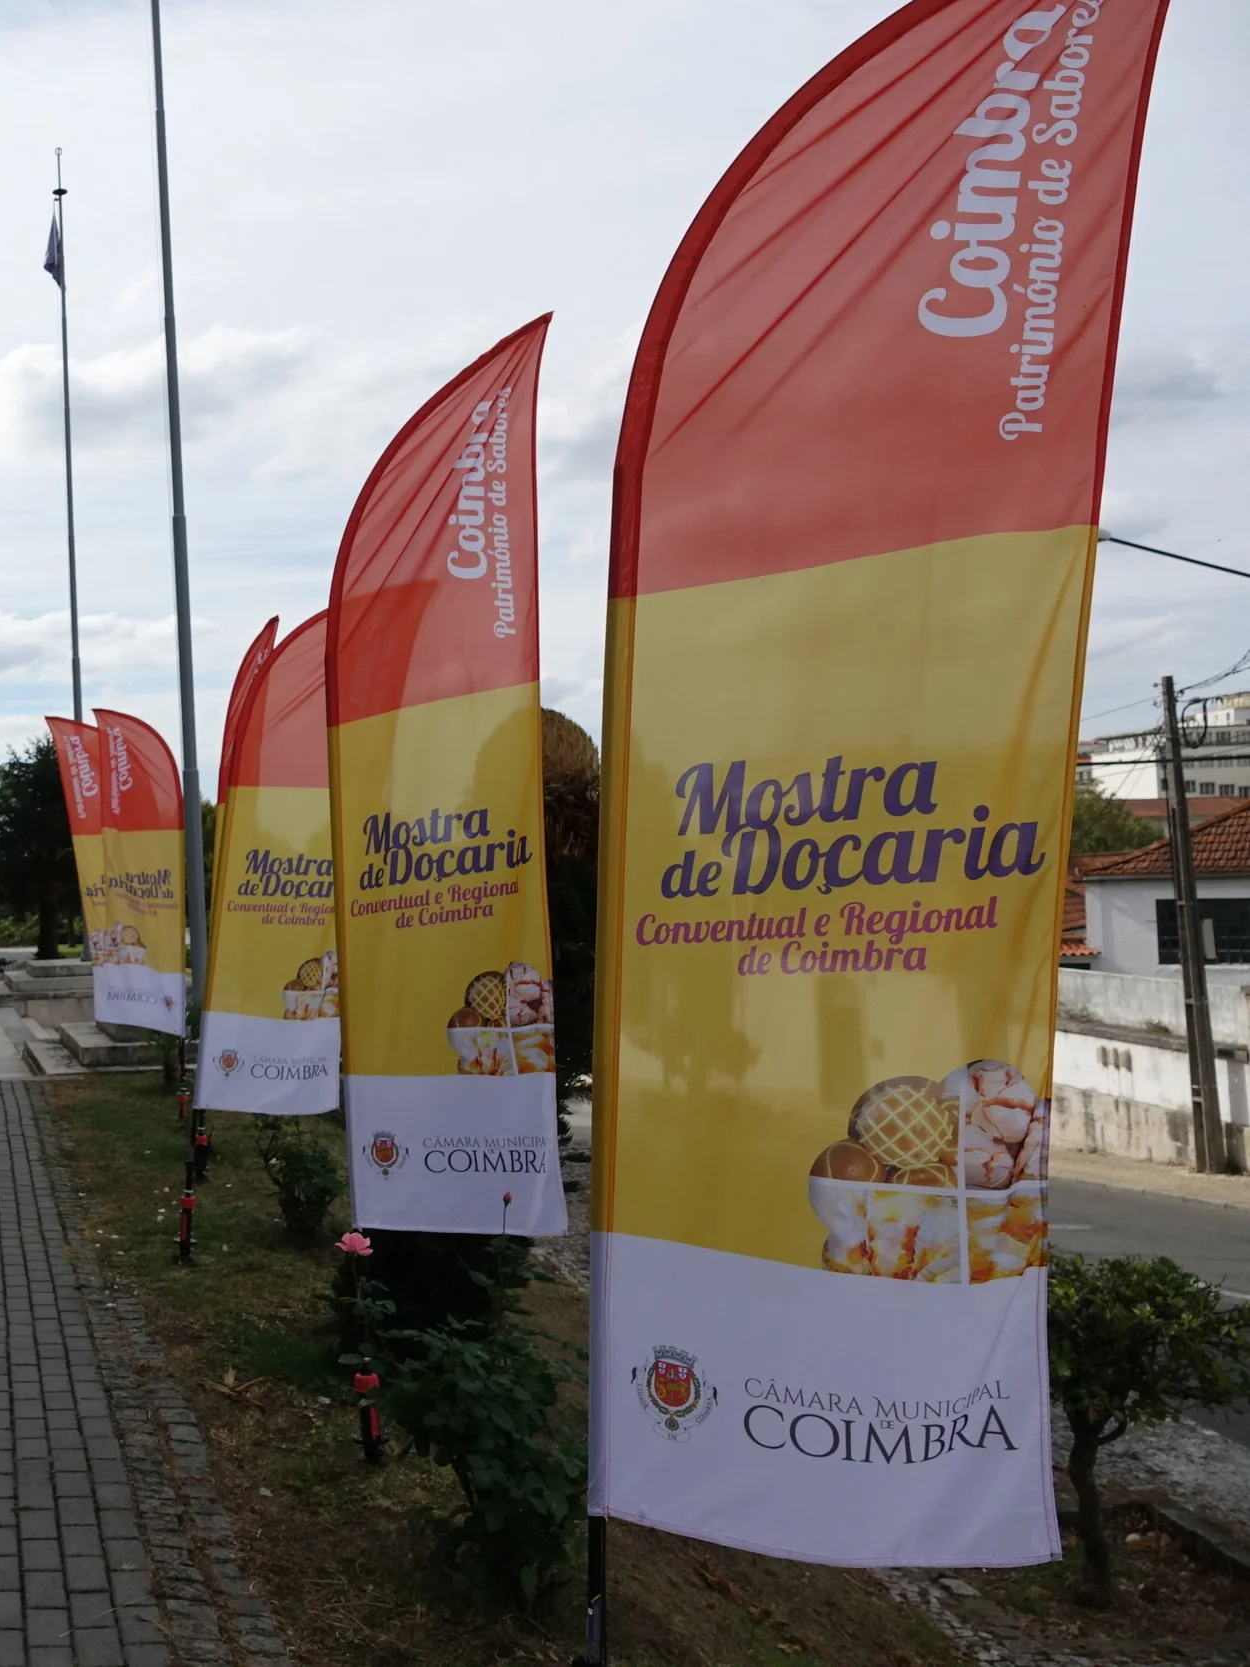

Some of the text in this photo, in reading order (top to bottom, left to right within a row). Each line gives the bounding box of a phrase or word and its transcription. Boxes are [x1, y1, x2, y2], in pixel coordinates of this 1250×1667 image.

[917, 3, 1066, 338] Coimbra
[1028, 158, 1073, 206] de
[998, 216, 1065, 441] Património
[446, 399, 493, 580] Coimbra
[487, 480, 507, 507] de
[486, 512, 516, 639] Património
[675, 755, 938, 837] Mostra
[362, 808, 491, 856] Mostra
[660, 804, 1046, 899] de Doçaria
[245, 849, 334, 876] Mostra
[359, 863, 385, 891] de
[237, 879, 259, 896] de
[350, 889, 431, 918] Conventual
[434, 891, 443, 905] e
[262, 913, 275, 925] de
[395, 904, 494, 929] de Coimbra
[635, 895, 999, 946] Conventual e Regional
[737, 940, 928, 977] de Coimbra
[250, 1063, 329, 1080] COIMBRA
[422, 1135, 548, 1150] CÂMARA MUNICIPA
[744, 1377, 1010, 1421] CÂMARA MUNICIPAL
[743, 1404, 1019, 1465] COIMBRA
[880, 1419, 895, 1431] DE
